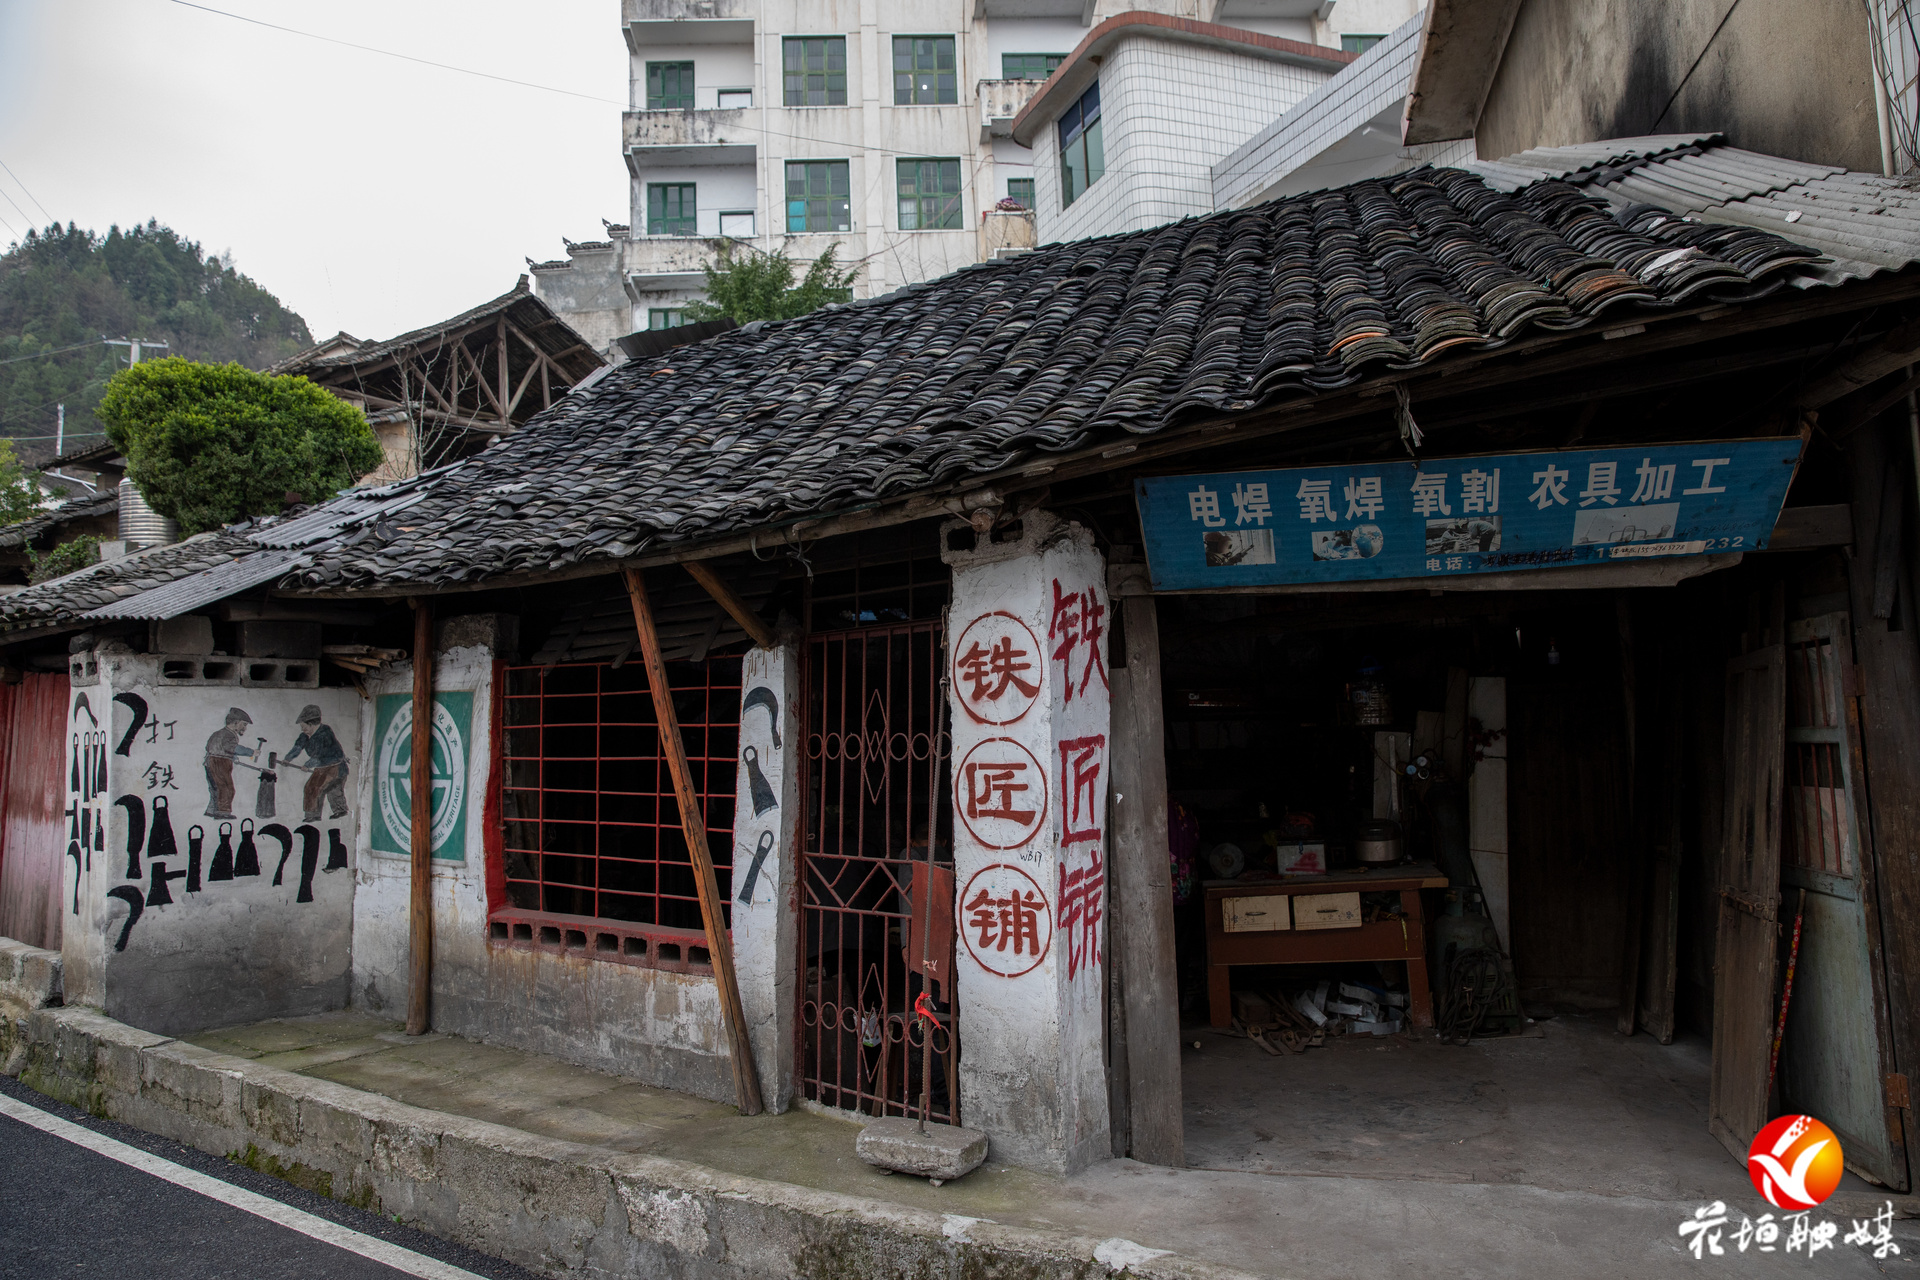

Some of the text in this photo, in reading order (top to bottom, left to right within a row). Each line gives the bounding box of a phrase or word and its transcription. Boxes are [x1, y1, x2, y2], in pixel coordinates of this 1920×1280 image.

[1188, 457, 1731, 528] 电焊 氧焊 氧割 农具加工
[381, 781, 389, 810] CHINA
[445, 784, 461, 829] HERITAGE
[957, 636, 1045, 956] 铁匠铺
